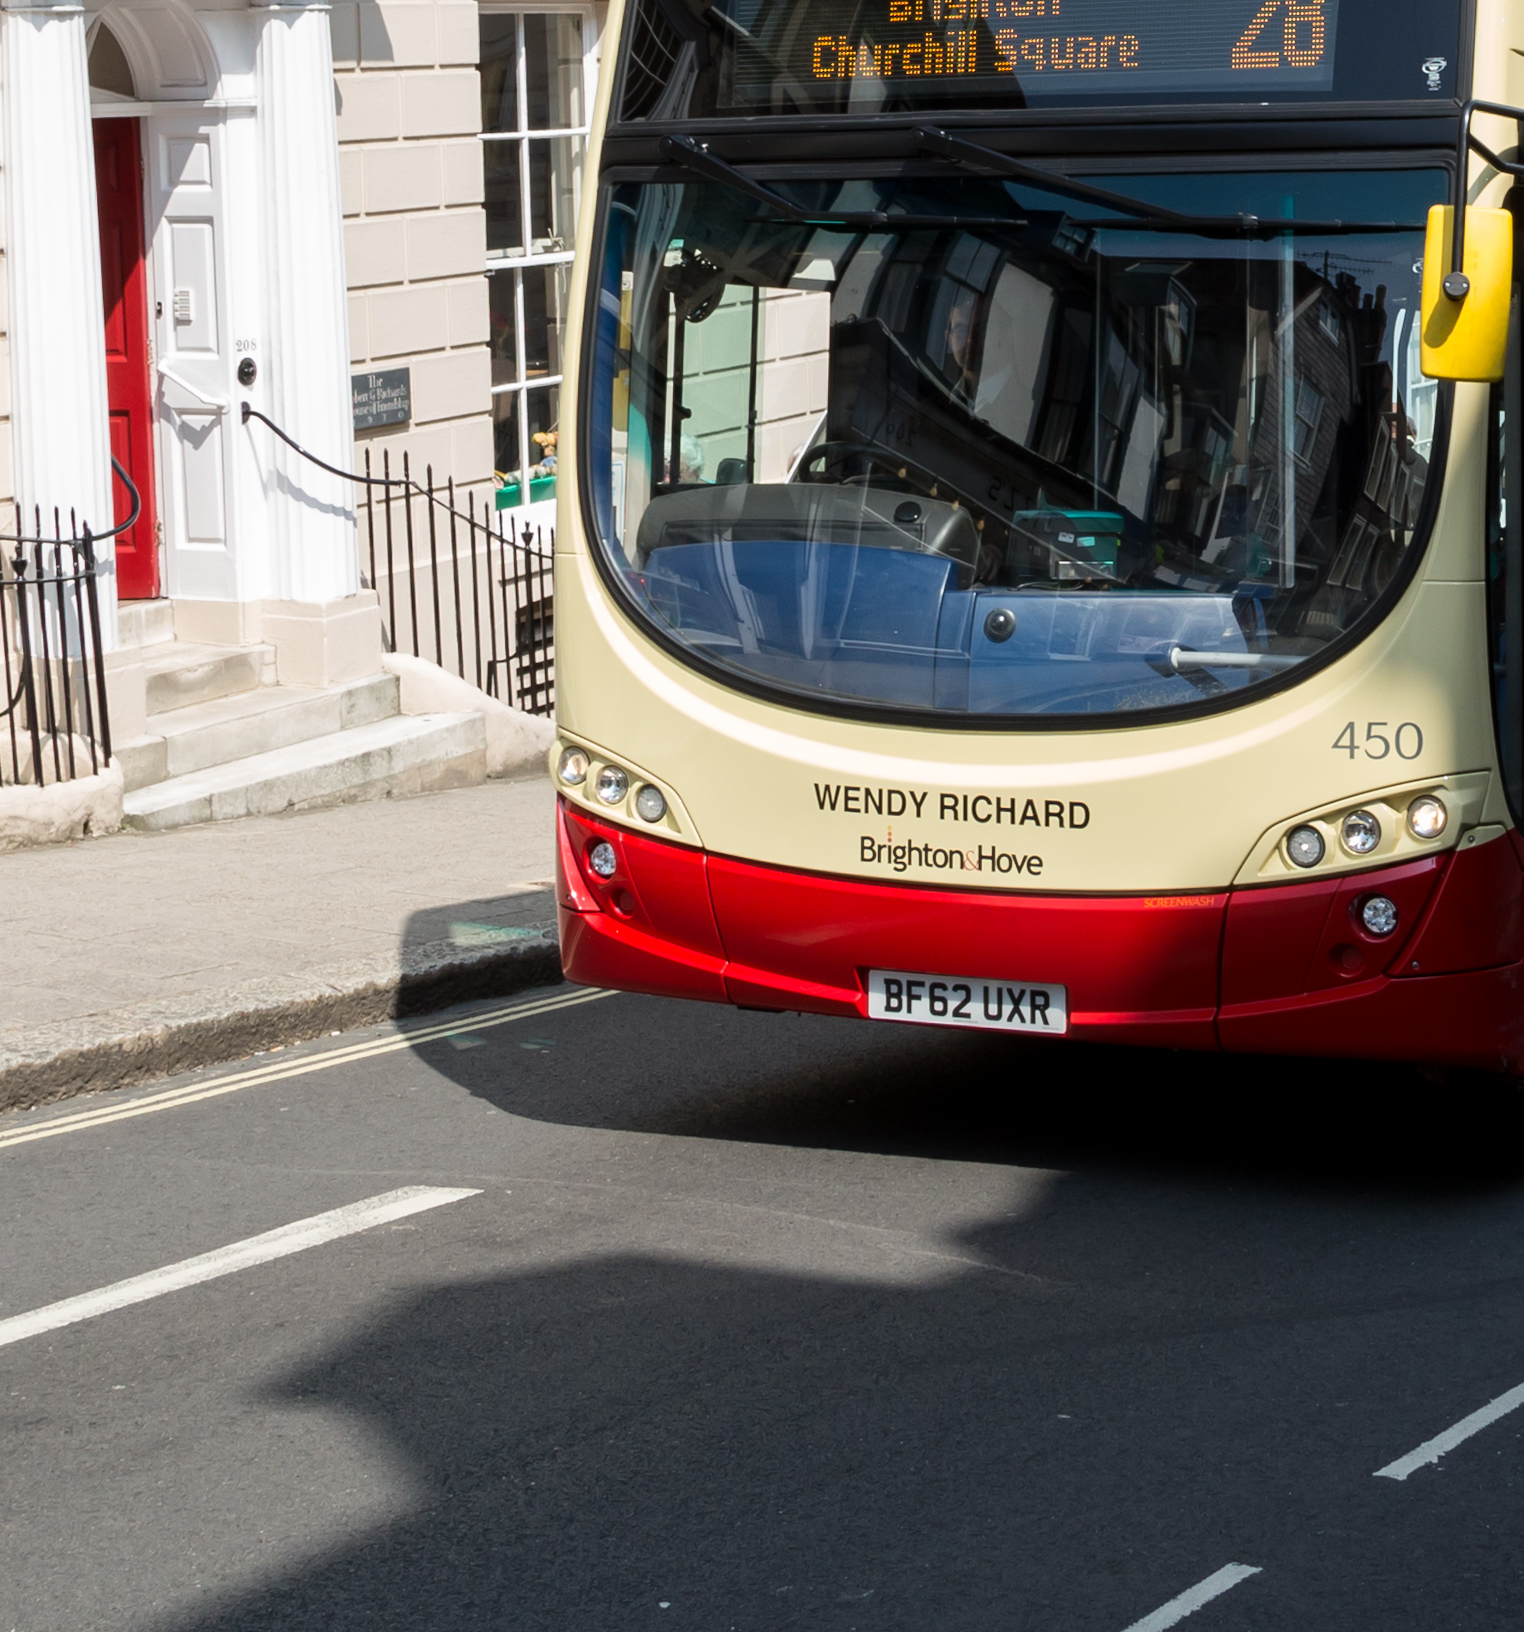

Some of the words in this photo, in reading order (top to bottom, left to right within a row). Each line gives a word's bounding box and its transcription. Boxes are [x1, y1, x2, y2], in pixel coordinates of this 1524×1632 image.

[813, 29, 977, 78] Churchill
[994, 28, 1139, 72] Square
[235, 339, 257, 353] 208
[1331, 721, 1423, 760] 450
[813, 783, 928, 818] WENDY
[939, 792, 1091, 829] RICHARD
[1143, 896, 1215, 909] SCREENWASH
[883, 977, 972, 1020] BF62
[983, 985, 1051, 1026] UXR
